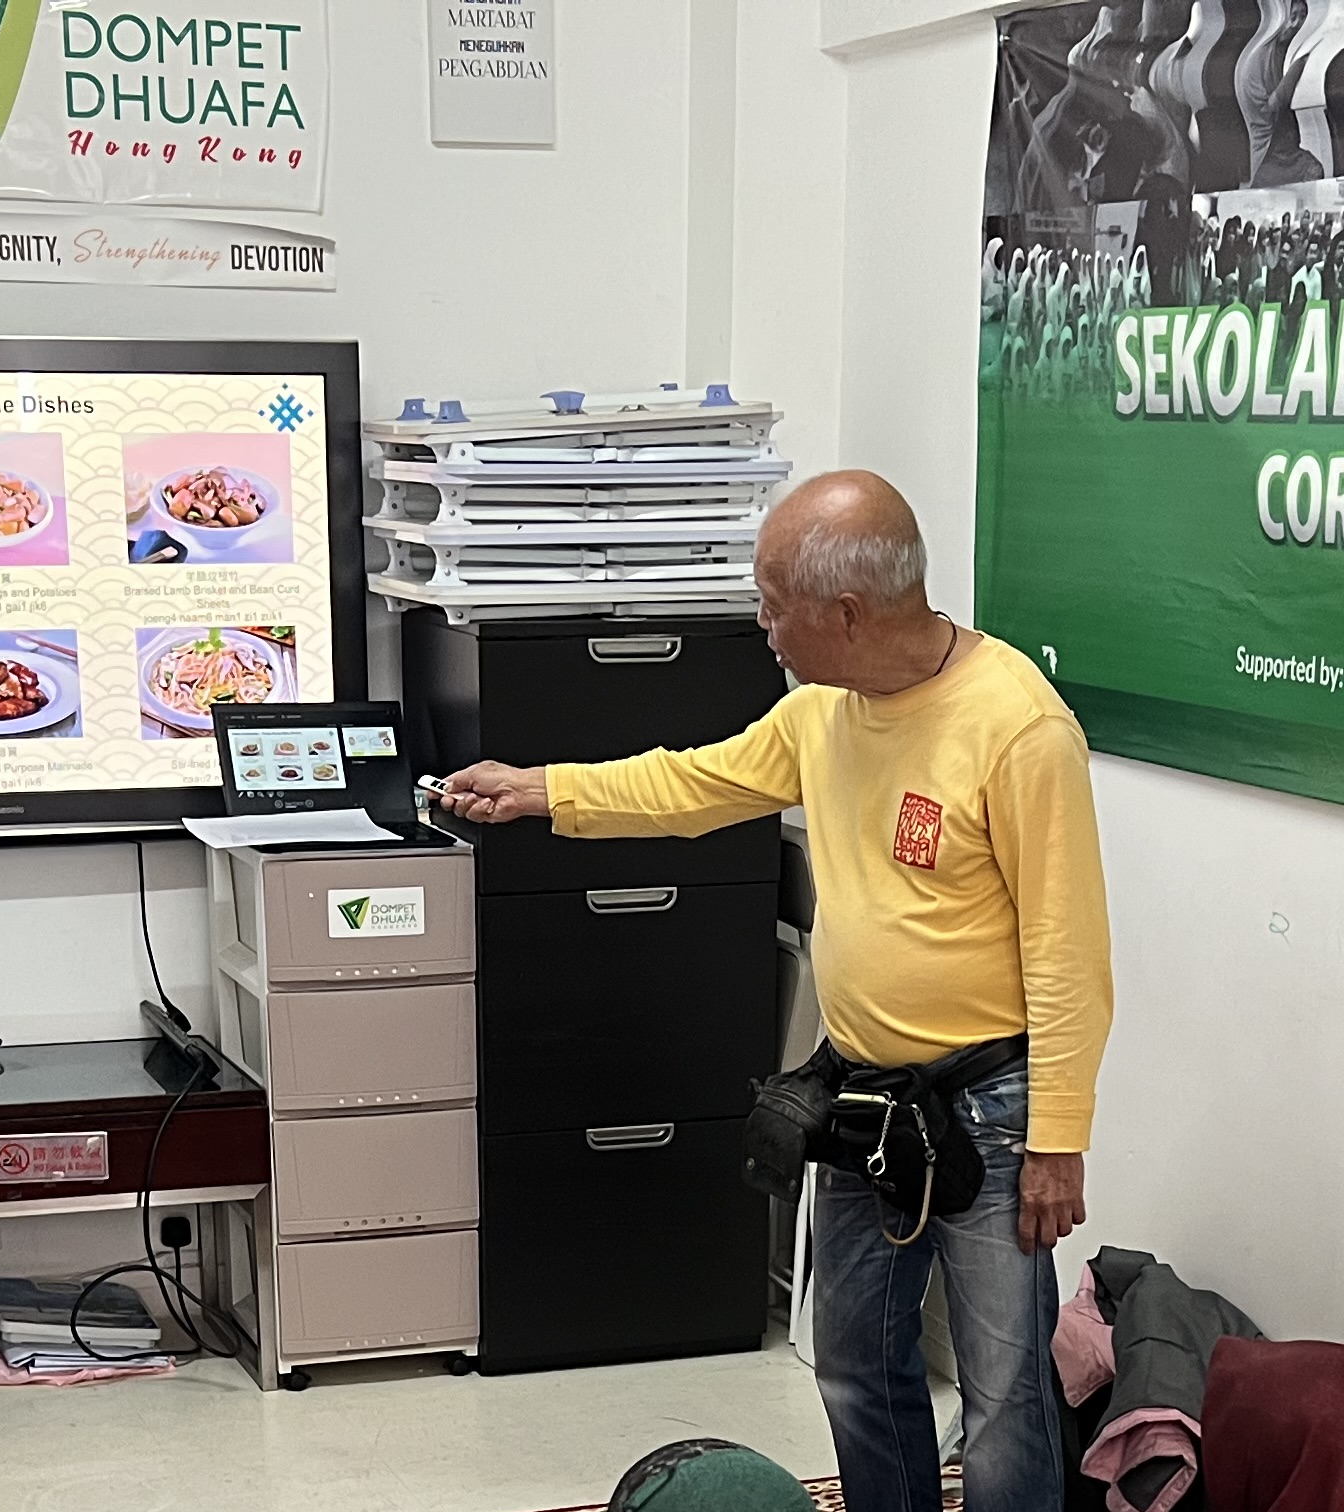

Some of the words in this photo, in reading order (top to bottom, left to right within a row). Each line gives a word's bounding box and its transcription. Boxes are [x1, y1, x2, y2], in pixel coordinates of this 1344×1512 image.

[448, 8, 536, 30] MARTABAT
[61, 10, 303, 71] DOMPET
[459, 39, 525, 54] MENEGUHKAN
[438, 58, 548, 79] PENGABDIAN
[64, 70, 306, 130] DHUAFA
[67, 129, 177, 164] Hong
[197, 136, 302, 169] Kong
[73, 229, 223, 272] Strengthening
[229, 244, 325, 274] DEVOTION
[22, 394, 95, 415] Dishes
[11, 587, 30, 599] and
[33, 586, 77, 598] Potatoes
[123, 585, 161, 597] Braised
[163, 584, 192, 597] Lamb
[193, 584, 227, 596] Brisket
[229, 583, 247, 596] and
[249, 584, 274, 595] Bean
[276, 583, 301, 595] Curd
[196, 598, 231, 610] Sheets
[1235, 645, 1316, 682] Supported
[1319, 656, 1344, 693] by:
[4, 762, 45, 777] Purpose
[371, 902, 416, 914] DOMPET
[371, 914, 417, 925] DHUAFA
